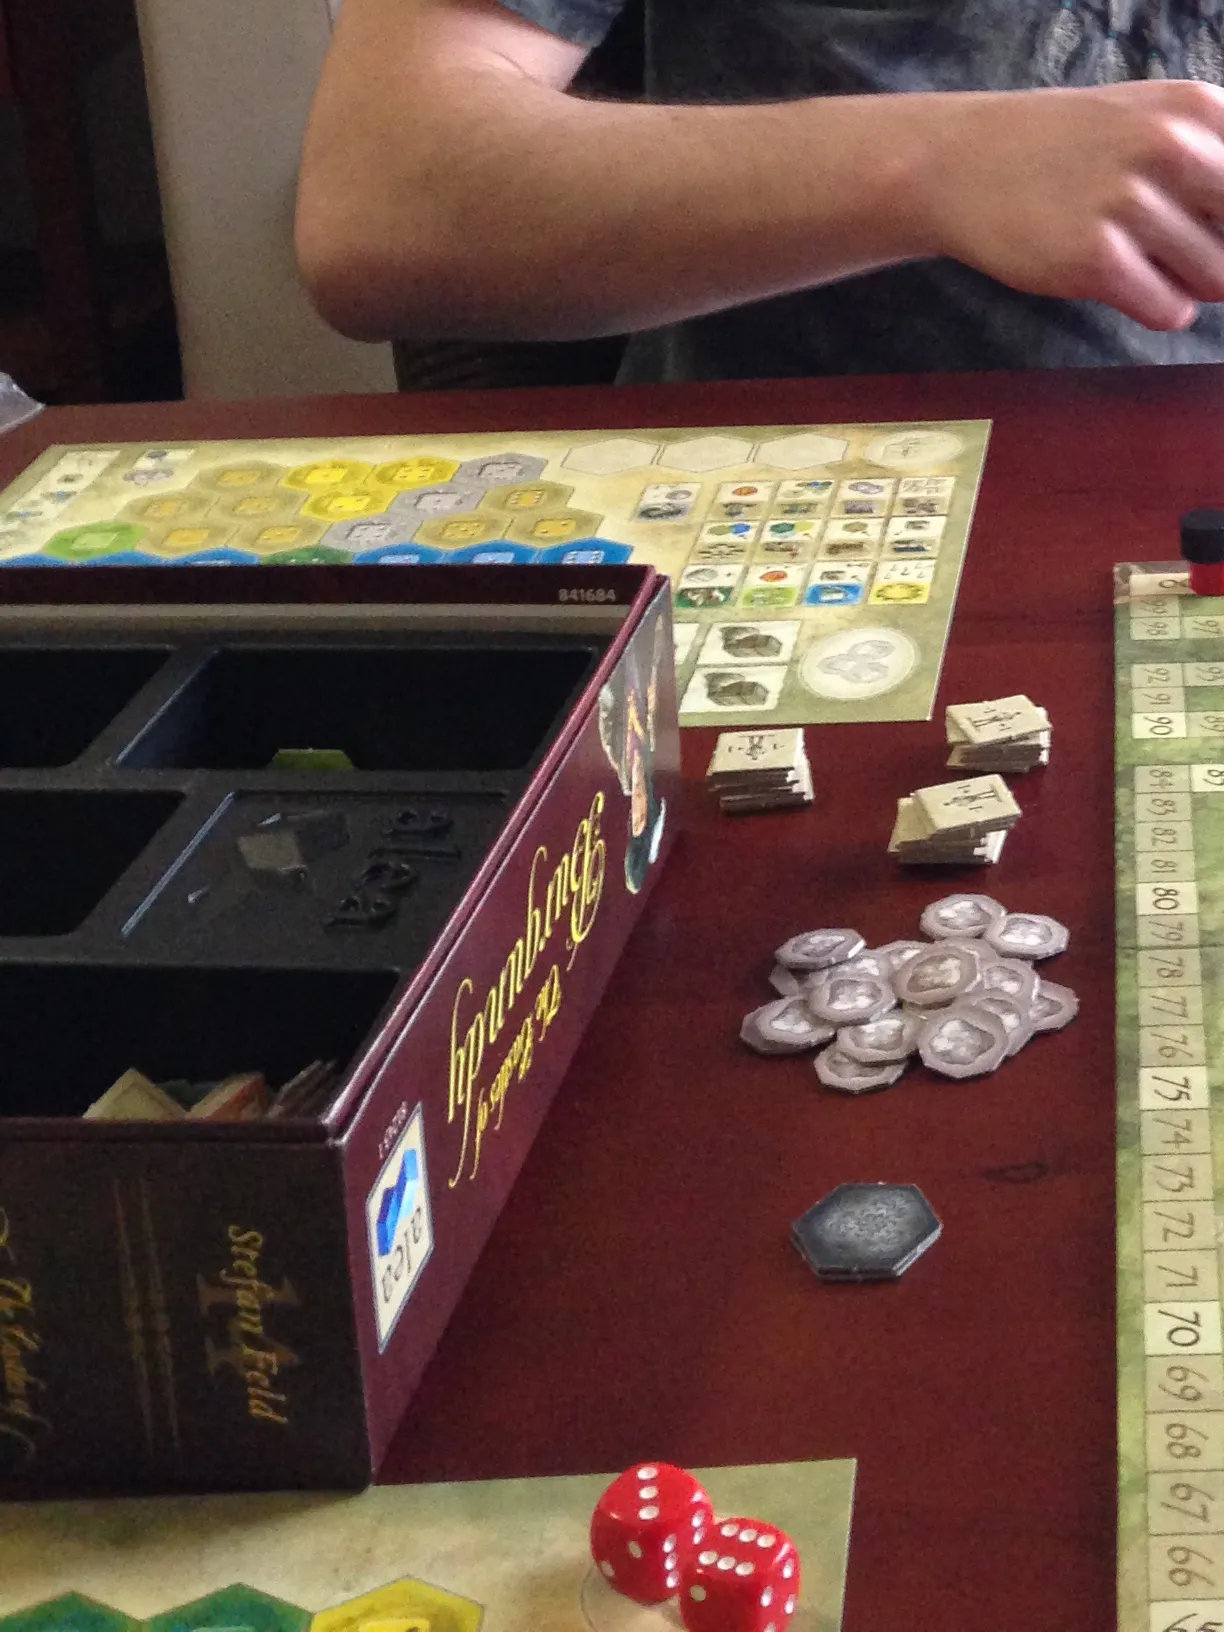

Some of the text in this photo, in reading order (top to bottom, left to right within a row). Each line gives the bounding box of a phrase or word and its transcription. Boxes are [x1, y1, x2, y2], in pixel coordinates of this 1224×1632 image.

[1194, 619, 1220, 635] 97
[1144, 667, 1170, 684] 92
[1143, 693, 1171, 706] 91
[1144, 716, 1173, 736] 90
[1147, 798, 1176, 816] 83
[1152, 827, 1176, 847] 82
[1151, 859, 1177, 874] 81
[1152, 887, 1179, 911] 80
[1149, 920, 1184, 942] 79
[1149, 955, 1184, 979] 78
[448, 791, 607, 1189] Burgundy
[1151, 995, 1189, 1019] 77
[1151, 1032, 1194, 1058] 76
[1152, 1075, 1191, 1102] 75
[1152, 1118, 1192, 1149] 74
[1154, 1164, 1195, 1193] 73
[1153, 1210, 1195, 1243] 72
[1156, 1265, 1198, 1287] 71
[1158, 1309, 1202, 1347] 70
[1158, 1365, 1210, 1403] 69
[1165, 1422, 1209, 1459] 68
[1160, 1482, 1216, 1523] 67
